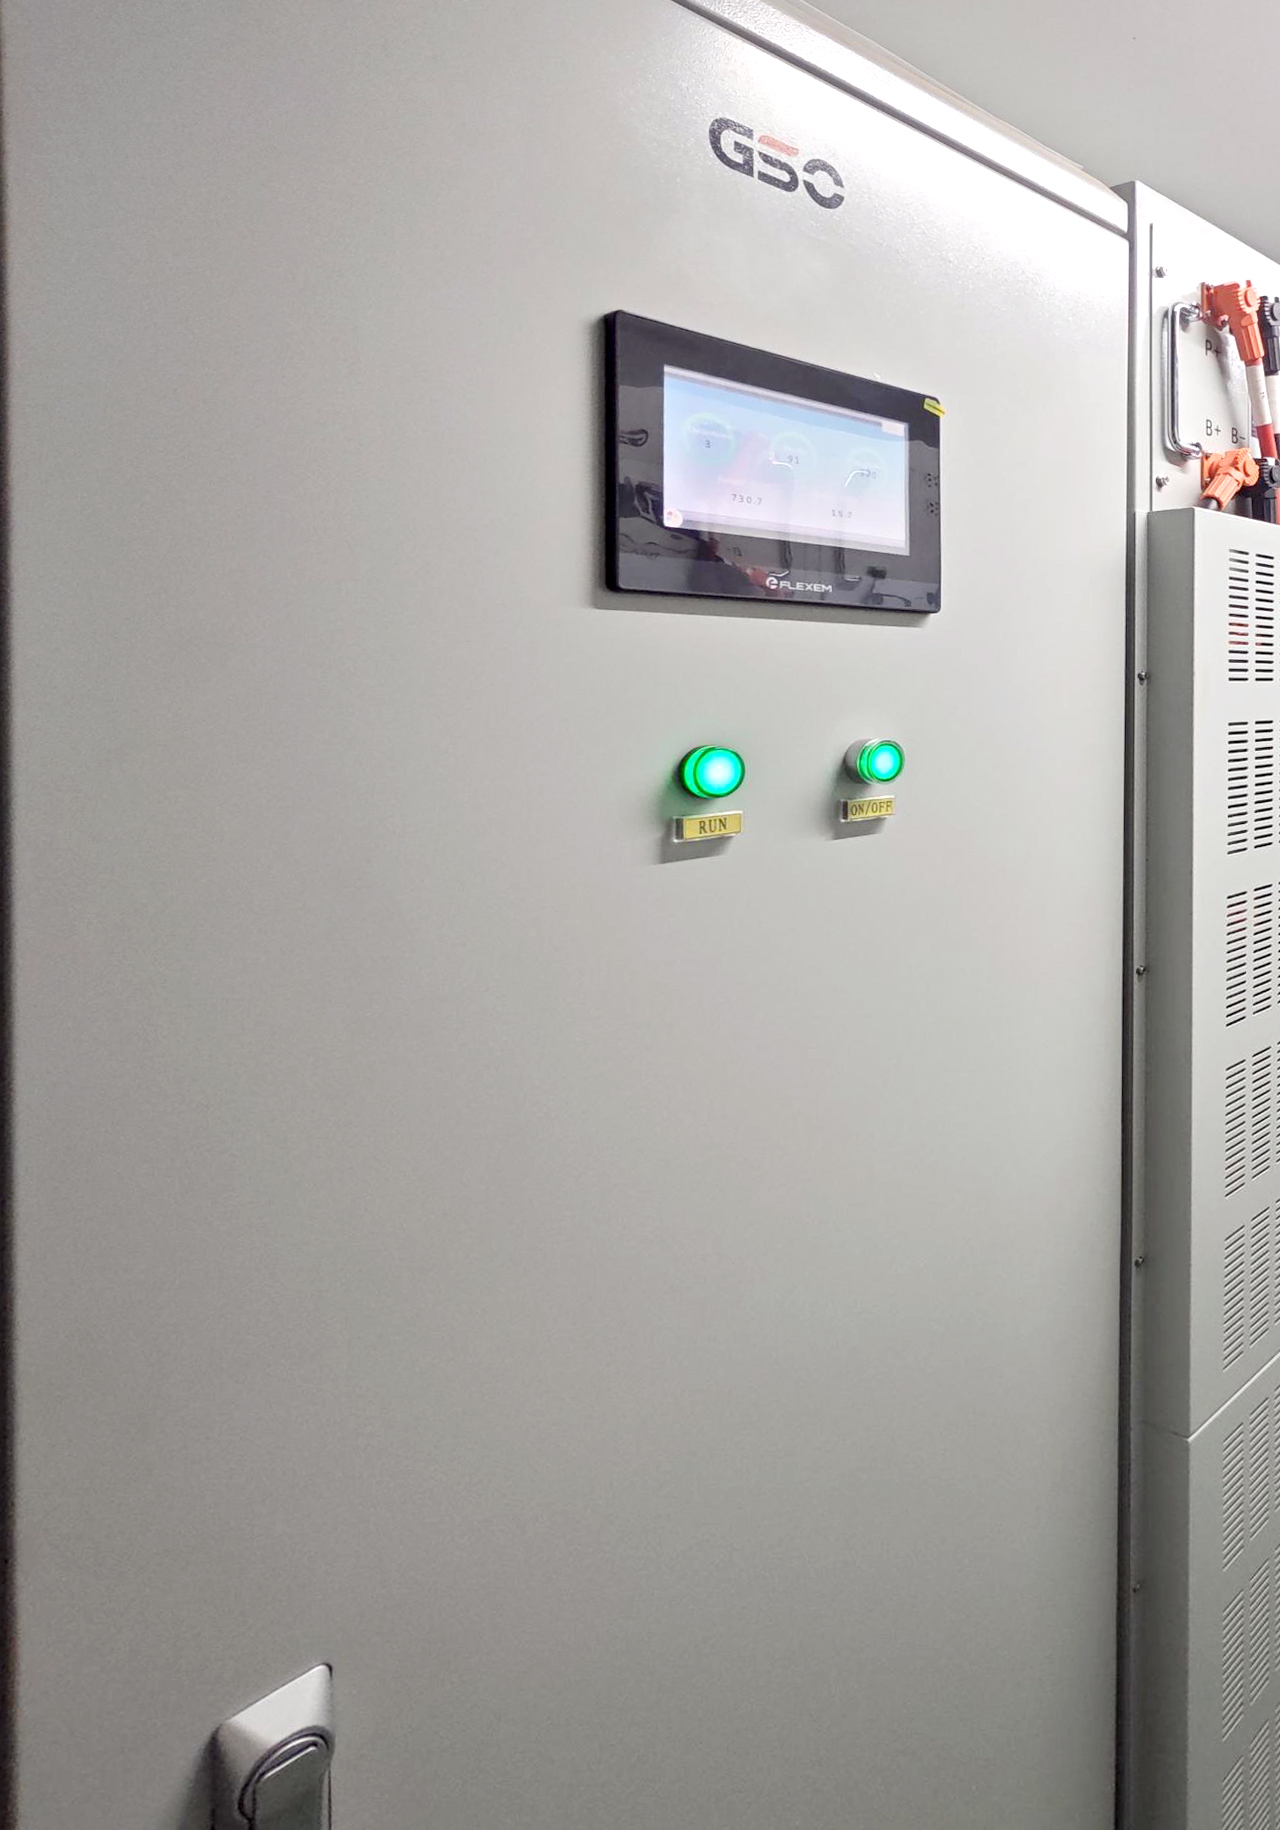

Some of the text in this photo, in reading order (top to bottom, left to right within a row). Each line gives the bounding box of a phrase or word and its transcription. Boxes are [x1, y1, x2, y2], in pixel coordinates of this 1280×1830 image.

[708, 116, 845, 210] GSO
[1205, 339, 1221, 357] P+
[1205, 418, 1246, 444] B+ B-
[731, 493, 763, 506] 730.7
[779, 580, 833, 593] FLEXEM
[850, 800, 893, 817] ON/OFF
[698, 817, 728, 835] RUN
